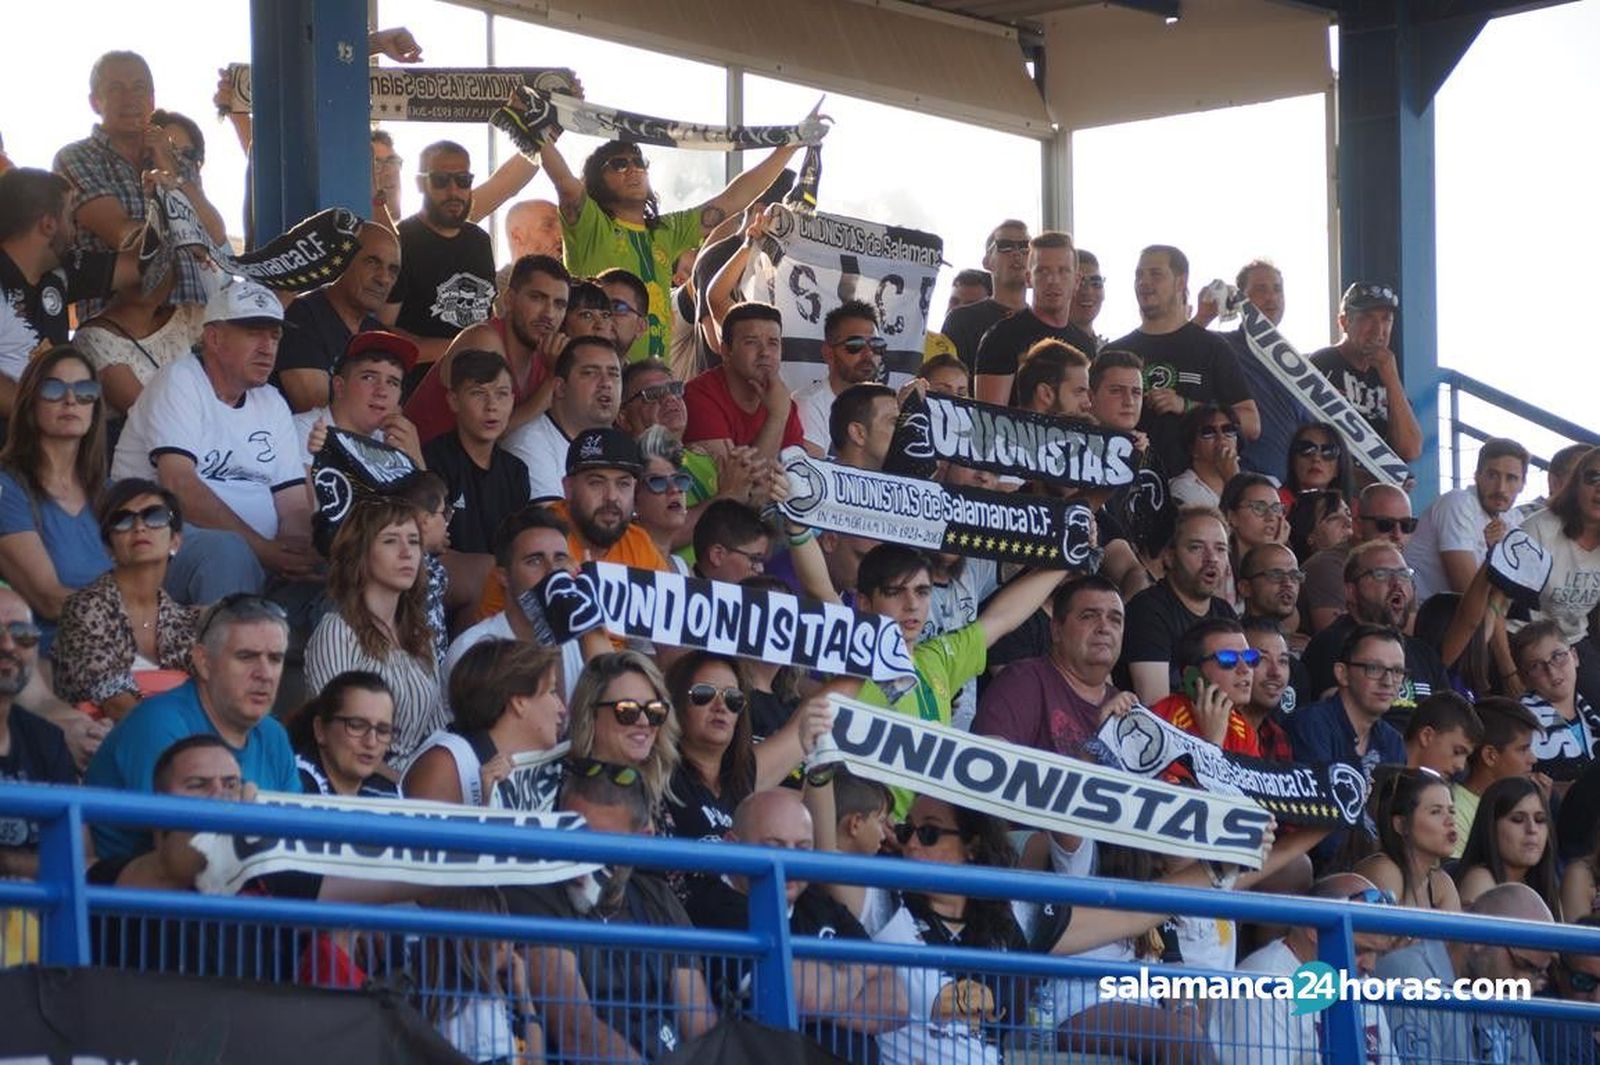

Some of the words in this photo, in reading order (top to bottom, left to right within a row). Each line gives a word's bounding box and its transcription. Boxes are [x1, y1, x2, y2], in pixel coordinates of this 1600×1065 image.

[927, 396, 1134, 487] UNIONISTAS
[832, 469, 921, 518] UNIONISTAS
[921, 489, 942, 521] de
[941, 490, 1028, 534] Salamanca
[1027, 504, 1057, 538] C.F.
[603, 578, 876, 668] UNIONISTAS
[831, 706, 1270, 851] UNIONISTAS
